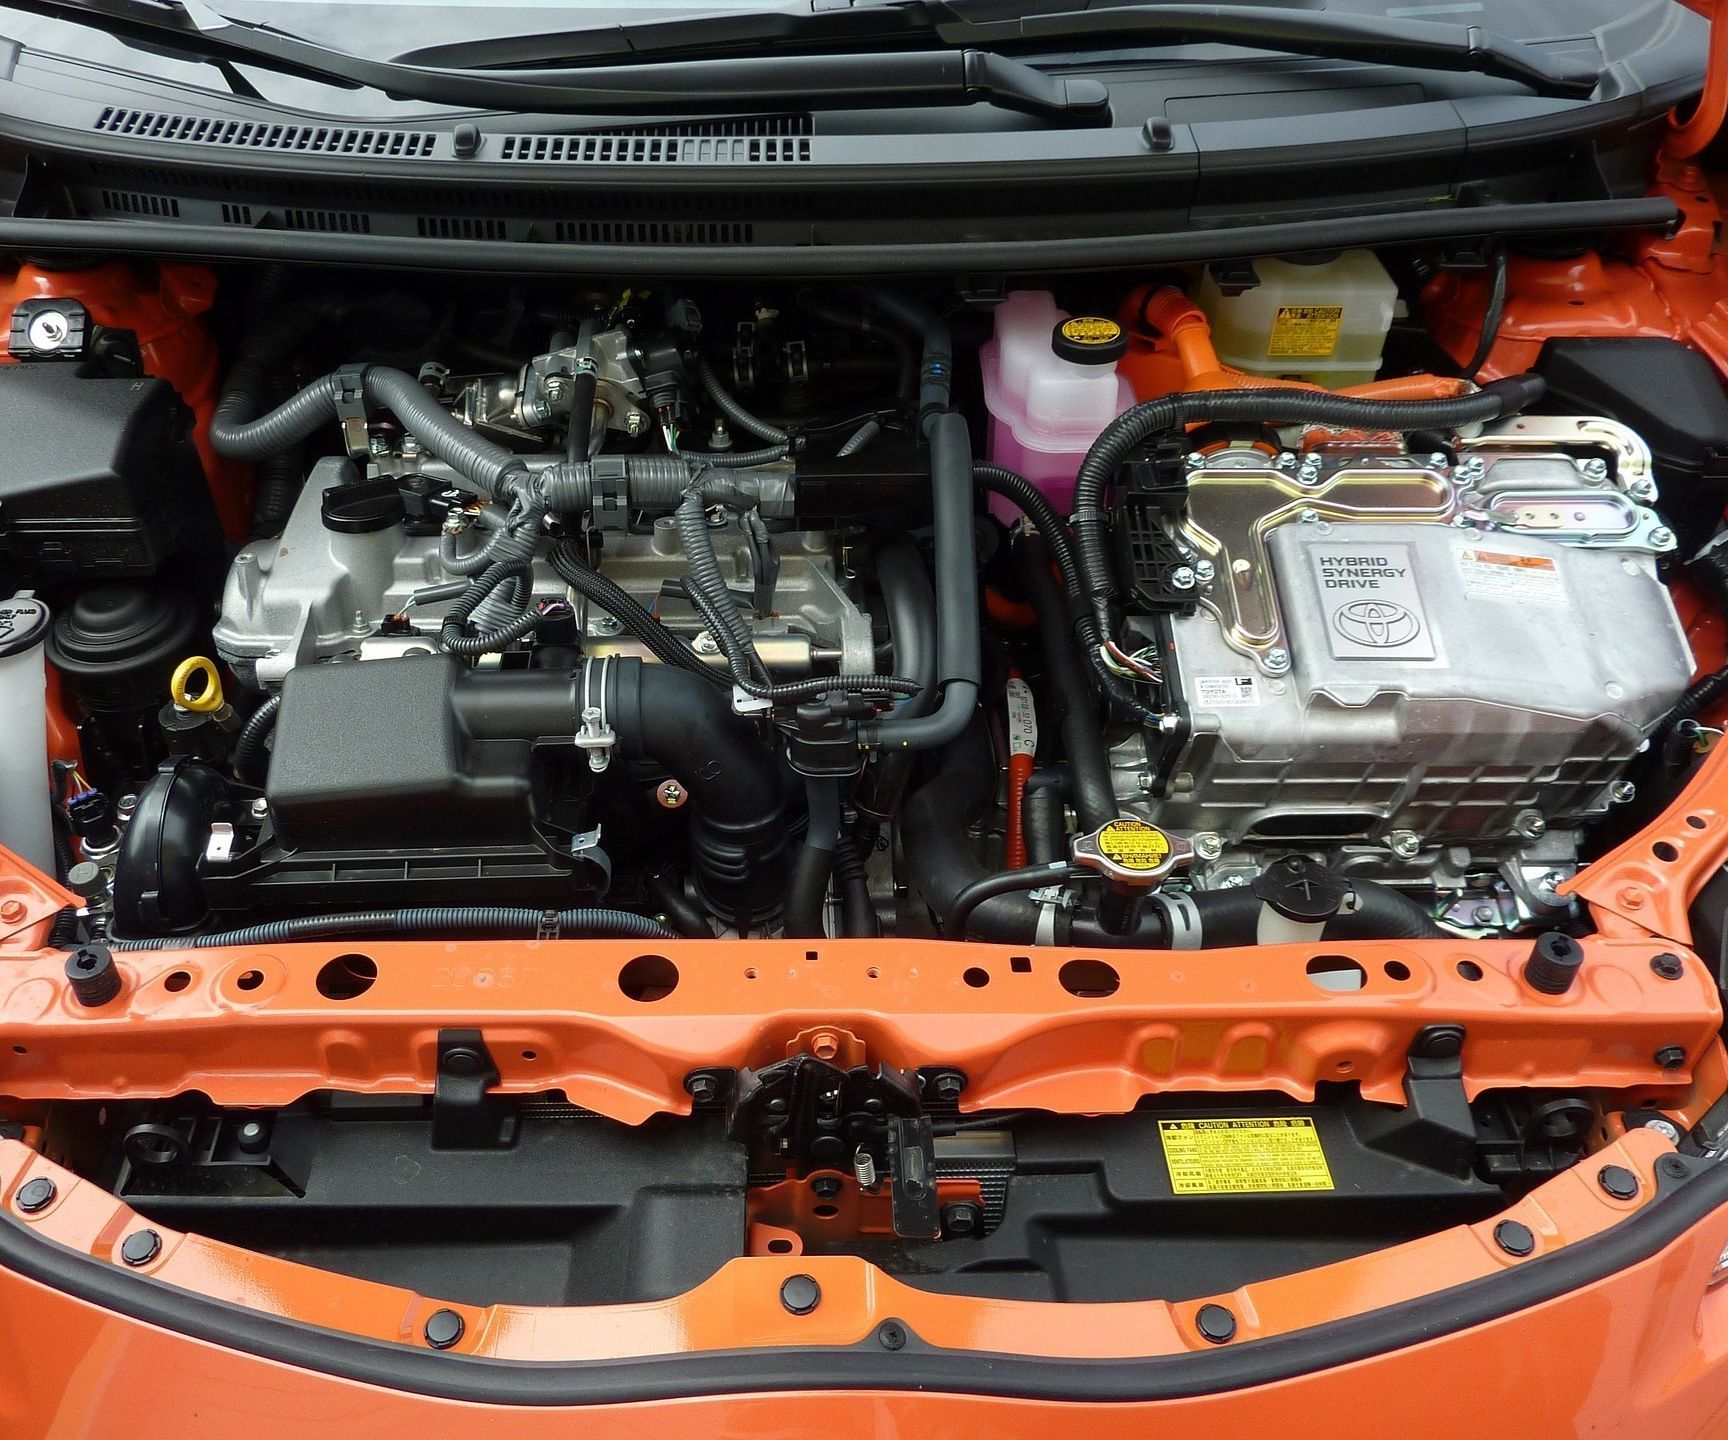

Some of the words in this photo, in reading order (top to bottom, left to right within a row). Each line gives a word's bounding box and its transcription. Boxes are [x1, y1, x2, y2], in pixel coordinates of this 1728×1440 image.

[1319, 556, 1389, 567] HYBRID
[1322, 568, 1407, 578] SYNERGY
[1325, 579, 1381, 589] DRIVE
[1198, 1121, 1229, 1129] CAUTION
[1232, 1120, 1270, 1128] ATTENTION
